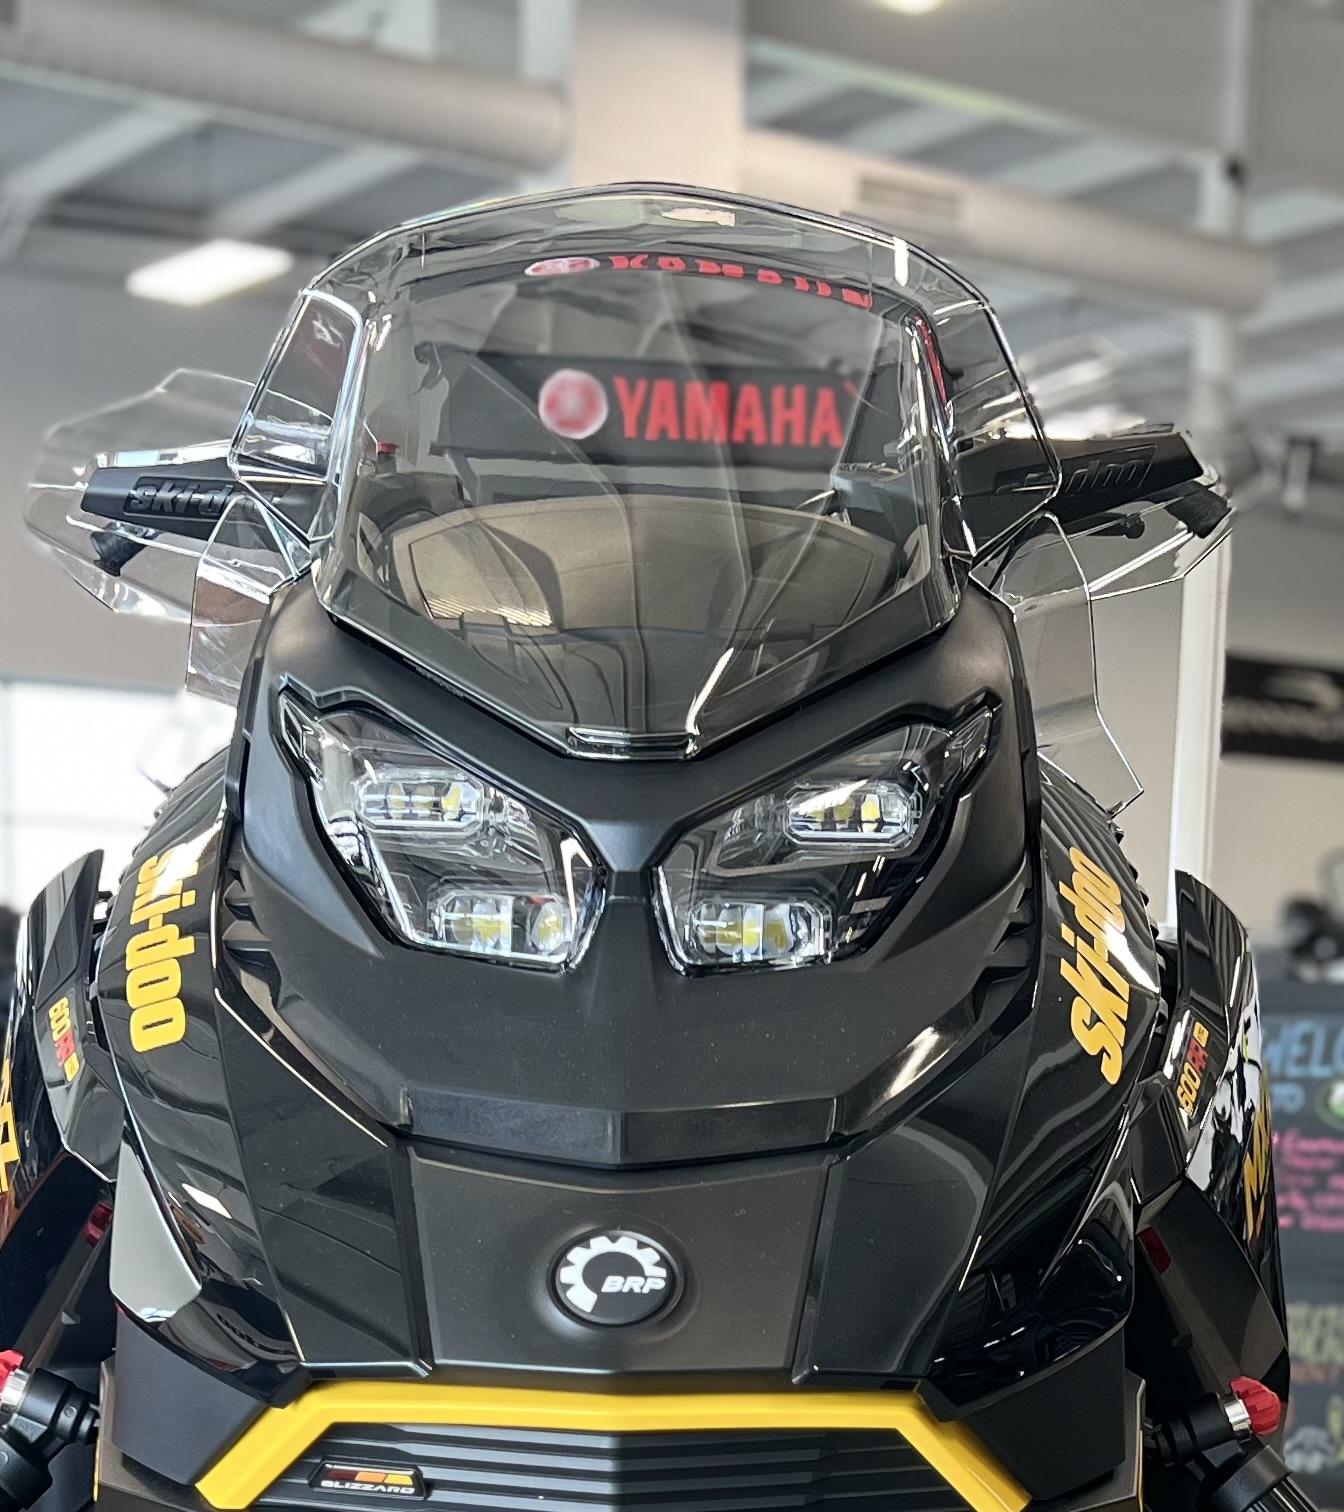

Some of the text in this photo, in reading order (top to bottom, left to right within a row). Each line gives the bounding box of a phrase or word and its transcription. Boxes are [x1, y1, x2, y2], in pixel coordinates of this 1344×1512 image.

[613, 377, 844, 448] YAMAHA
[1059, 846, 1131, 1086] ski-doo
[600, 1275, 666, 1294] BRP
[320, 1480, 416, 1495] BLIZZARD
